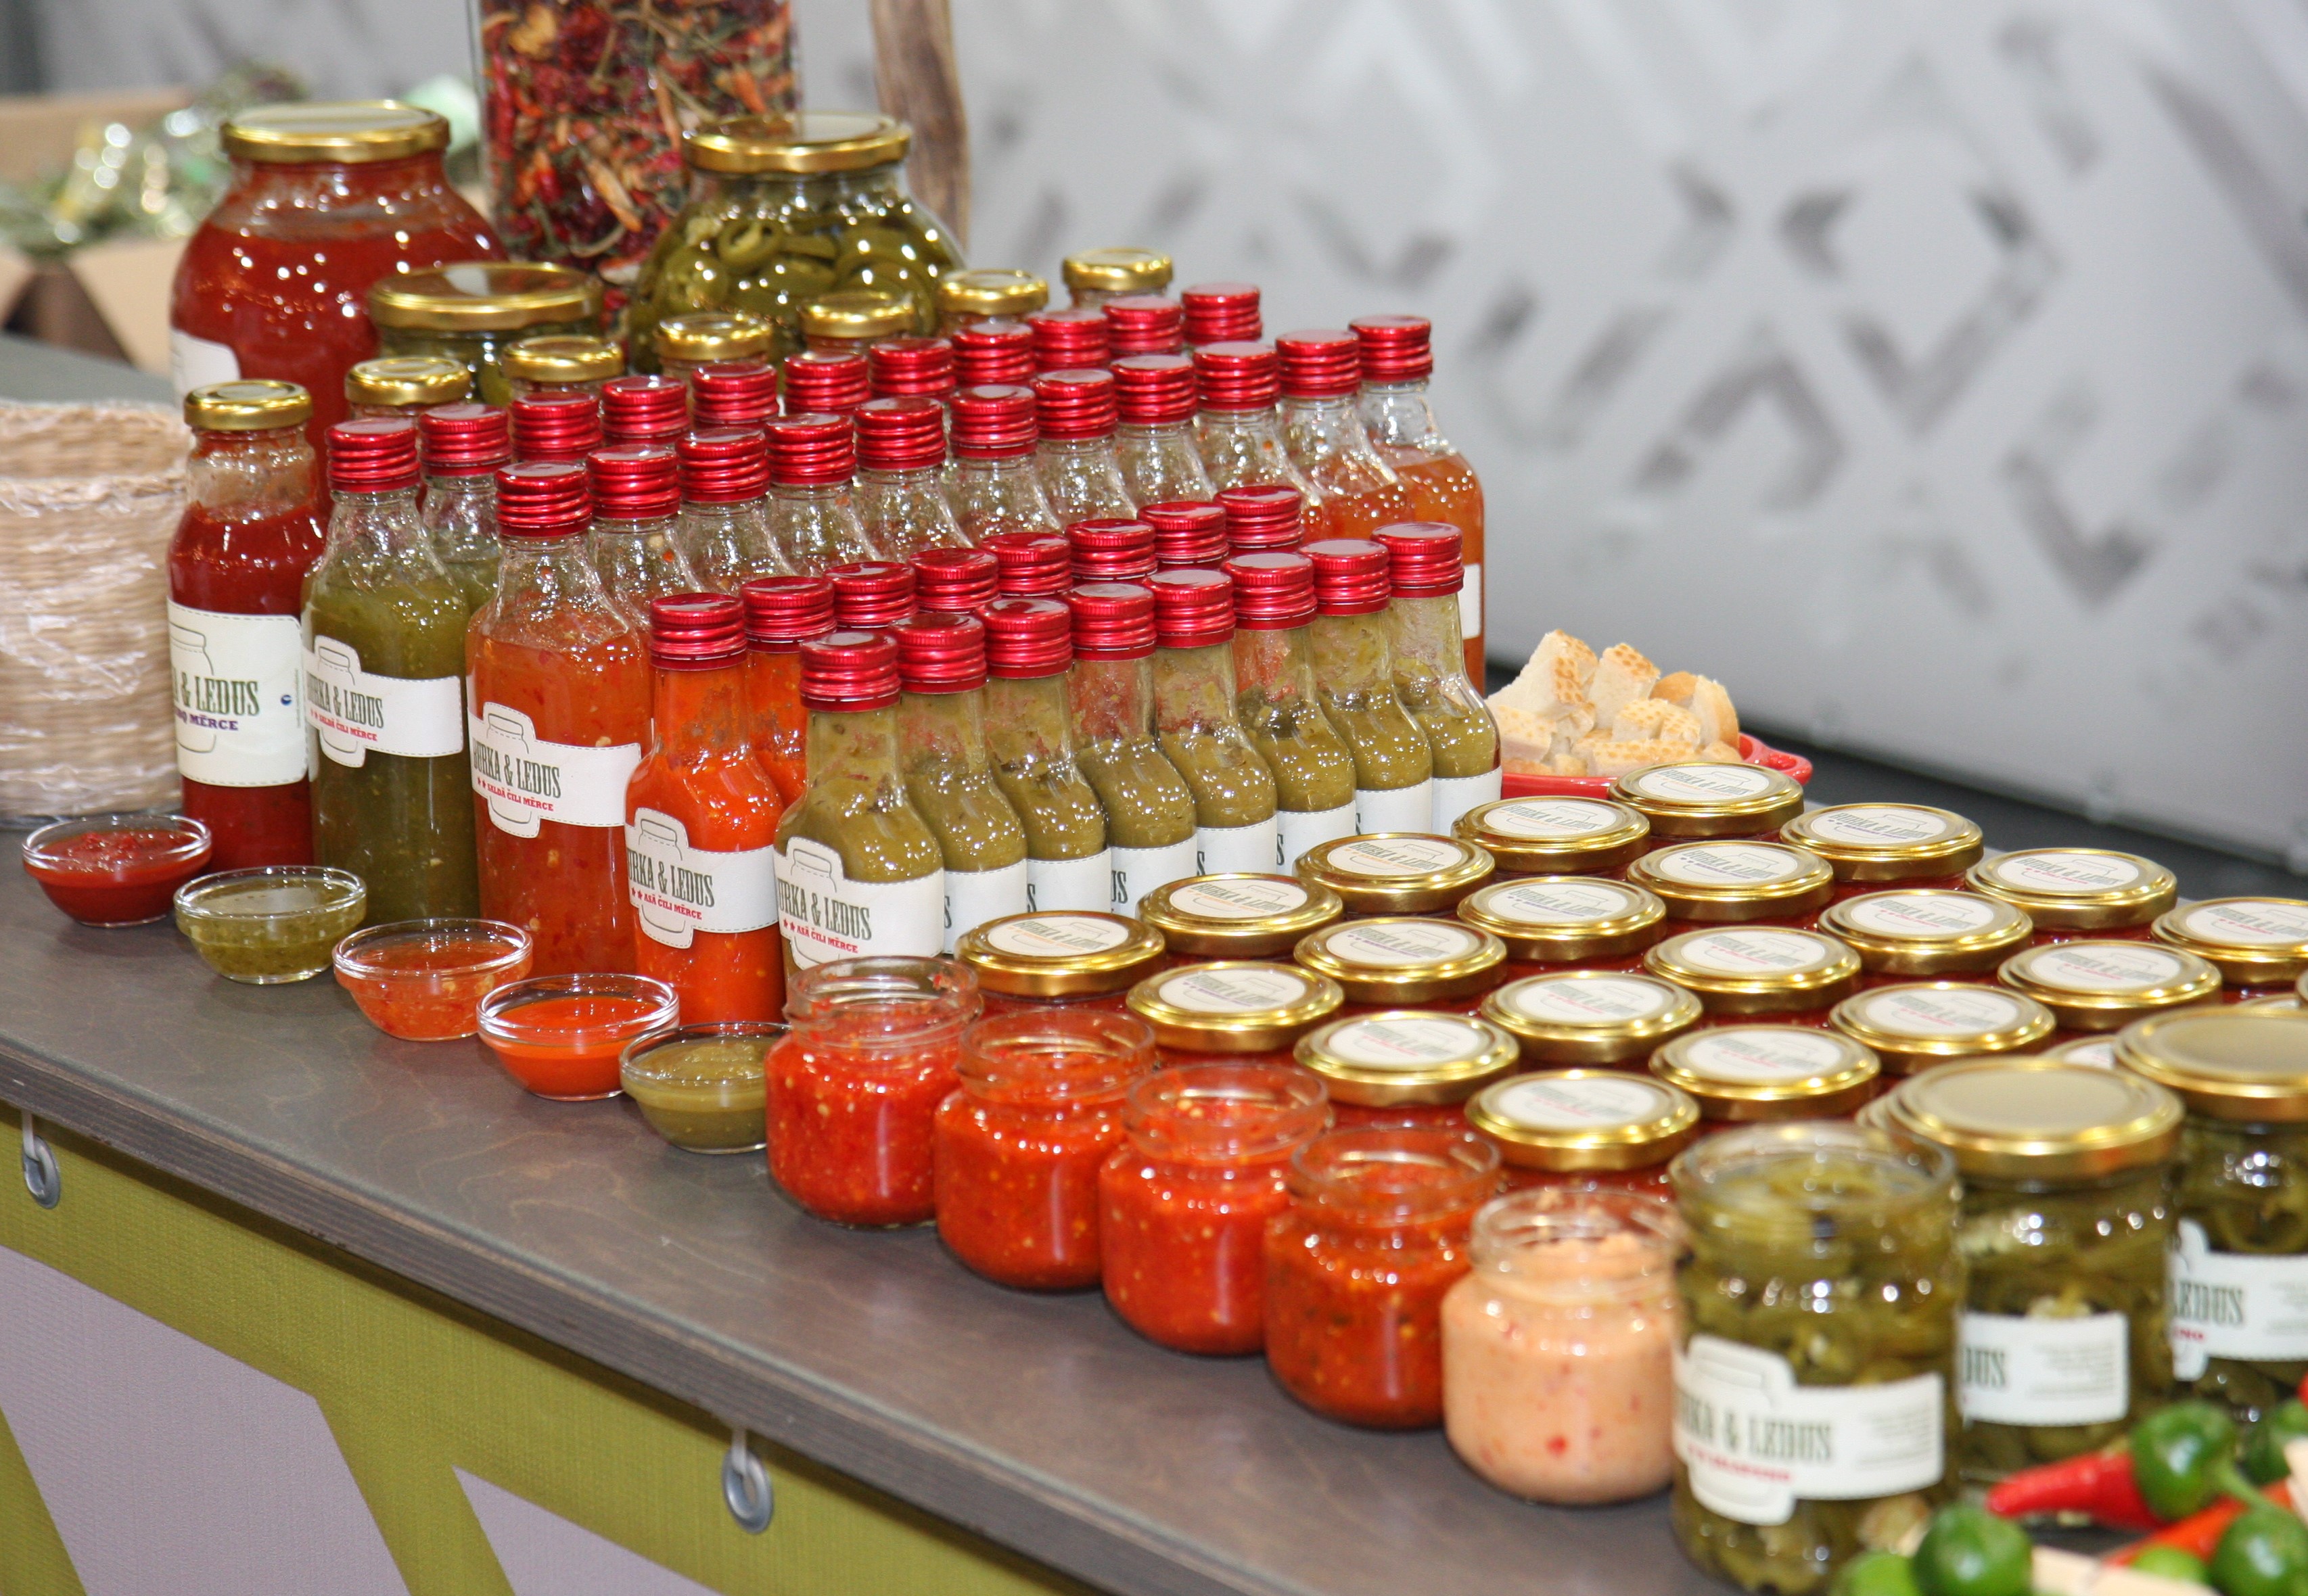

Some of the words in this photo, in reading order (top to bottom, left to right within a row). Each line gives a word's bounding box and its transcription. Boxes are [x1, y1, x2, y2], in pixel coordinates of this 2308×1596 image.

[195, 676, 260, 715] LEDUS
[333, 686, 341, 717] &
[343, 689, 384, 728] LEDUS
[189, 714, 239, 731] MĒRCE
[350, 726, 377, 741] MĒRCE
[504, 754, 513, 786] &
[516, 757, 561, 798] LEDUS
[524, 797, 554, 812] MĒRCE
[657, 861, 667, 894] &
[670, 865, 714, 908] LEDUS
[674, 904, 702, 920] MĒRCE
[812, 893, 821, 926] &
[824, 897, 872, 940] LEDUS
[828, 937, 858, 954] MĒRCE
